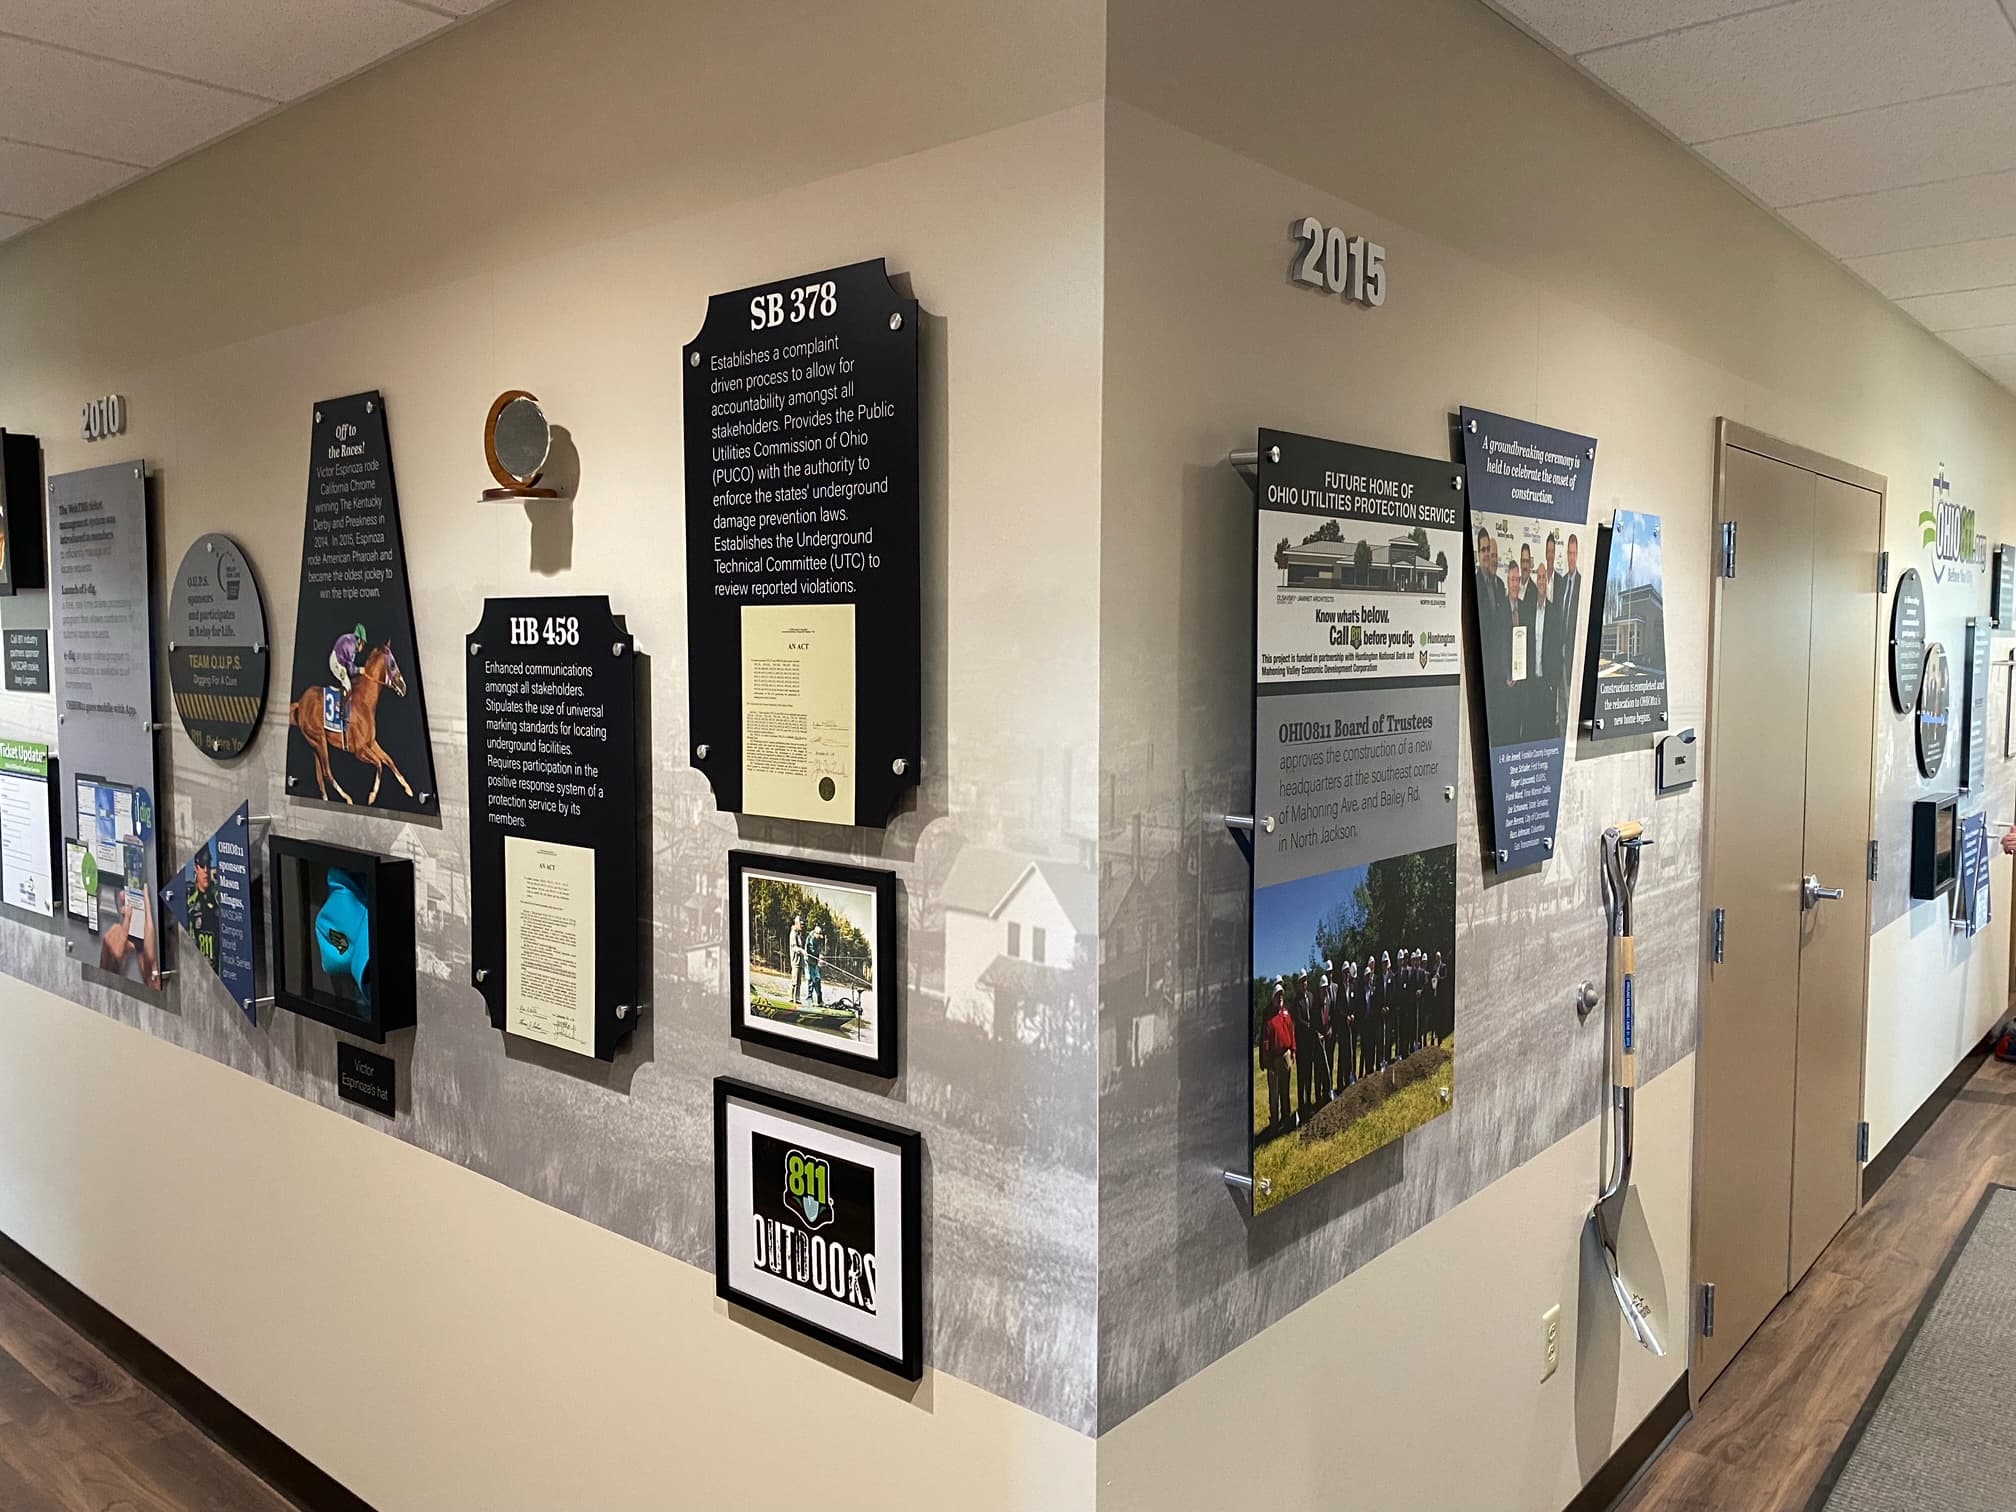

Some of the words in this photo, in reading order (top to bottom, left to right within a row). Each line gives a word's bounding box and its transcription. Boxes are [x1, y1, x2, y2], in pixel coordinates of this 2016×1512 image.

[1294, 217, 1386, 306] 2015
[750, 292, 784, 331] SB
[790, 281, 836, 322] 378
[710, 348, 769, 371] Establishes
[772, 348, 779, 360] a
[782, 335, 839, 359] complaint
[710, 377, 742, 393] driven
[746, 370, 788, 392] process
[791, 367, 802, 381] to
[805, 361, 835, 379] allow
[839, 357, 854, 373] for
[711, 392, 785, 416] accountability
[788, 384, 837, 406] amongst
[840, 380, 853, 398] all
[81, 394, 121, 439] 2010
[711, 417, 780, 439] stakeholders.
[784, 410, 832, 429] Provides
[835, 407, 854, 423] the
[858, 401, 894, 420] Public
[335, 423, 348, 441] Off
[348, 424, 356, 436] to
[712, 443, 750, 461] Utilities
[753, 436, 821, 457] Commission
[825, 431, 837, 449] of
[839, 429, 868, 447] Ohio
[328, 445, 340, 459] the
[341, 440, 365, 457] Races!
[1481, 436, 1488, 449] A
[1488, 439, 1544, 464] groundbreaking
[1544, 451, 1574, 470] ceremony
[1574, 454, 1580, 468] is
[712, 465, 754, 487] (PUCO)
[757, 463, 780, 479] with
[783, 461, 801, 477] the
[803, 455, 854, 475] authority
[858, 455, 870, 470] to
[1486, 458, 1502, 474] held
[1503, 462, 1510, 475] to
[1511, 463, 1541, 481] celebrate
[1541, 468, 1552, 483] the
[1552, 474, 1568, 486] onset
[1568, 473, 1577, 491] of
[712, 489, 752, 507] enforce
[754, 487, 772, 503] the
[774, 483, 809, 502] states'
[812, 476, 887, 500] underground
[1325, 471, 1366, 492] FUTURE
[1369, 478, 1398, 497] HOME
[1400, 482, 1413, 499] OF
[1511, 487, 1553, 504] construction.
[1268, 485, 1298, 504] OHIO
[1301, 489, 1351, 511] UTILITIES
[1354, 496, 1416, 519] PROTECTION
[1418, 504, 1455, 524] SERVICE
[713, 513, 756, 531] damage
[759, 507, 816, 529] prevention
[820, 506, 848, 521] laws.
[714, 534, 773, 551] Establishes
[775, 532, 793, 548] the
[796, 527, 872, 549] Underground
[713, 556, 762, 573] Technical
[765, 555, 827, 571] Committee
[830, 552, 864, 572] (UTC)
[868, 553, 880, 568] to
[714, 580, 748, 596] review
[751, 578, 797, 598] reported
[800, 578, 856, 593] violations.
[1315, 608, 1336, 623] Know
[1336, 609, 1359, 623] what's
[1360, 605, 1389, 623] below.
[510, 617, 539, 644] HB
[542, 616, 579, 645] 458
[1329, 625, 1349, 645] Call
[1363, 630, 1387, 645] before
[1388, 633, 1401, 648] you
[1401, 630, 1415, 647] dig.
[188, 654, 209, 668] TEAM
[211, 655, 242, 670] O.U.P.S.
[485, 660, 523, 674] Enhanced
[524, 663, 592, 677] communications
[485, 682, 518, 696] amongst
[520, 681, 529, 694] all
[531, 682, 584, 696] stakeholders.
[326, 693, 334, 721] 3
[485, 698, 523, 713] Stipulates
[524, 700, 538, 713] the
[539, 704, 554, 714] use
[555, 702, 564, 715] of
[566, 704, 603, 717] universal
[486, 717, 517, 734] marking
[518, 720, 558, 734] standards
[559, 721, 571, 735] for
[573, 722, 606, 741] locating
[1278, 721, 1331, 743] OHIO811
[1333, 718, 1369, 737] Board
[1372, 714, 1384, 733] of
[1386, 714, 1432, 732] Trustees
[486, 737, 536, 753] underground
[538, 740, 572, 755] facilities.
[1280, 751, 1324, 773] approves
[1326, 747, 1341, 764] the
[1343, 741, 1396, 762] construction
[1398, 738, 1407, 754] of
[1408, 743, 1413, 753] a
[1415, 740, 1432, 752] new
[487, 754, 521, 770] Requires
[522, 758, 572, 775] participation
[574, 762, 582, 775] in
[584, 763, 598, 777] the
[487, 775, 517, 788] positive
[518, 779, 555, 792] response
[556, 783, 585, 797] system
[587, 784, 596, 797] of
[598, 787, 603, 798] a
[1279, 775, 1342, 800] headquarters
[1343, 772, 1353, 787] at
[1355, 770, 1369, 785] the
[1371, 765, 1411, 783] southeast
[1413, 762, 1438, 777] corner
[488, 794, 526, 808] protection
[528, 798, 556, 812] service
[558, 799, 568, 816] by
[570, 801, 580, 815] its
[1278, 805, 1289, 824] of
[1291, 799, 1338, 824] Mahoning
[1340, 797, 1359, 816] Ave.
[1361, 792, 1378, 810] and
[1380, 789, 1405, 807] Bailey
[1407, 786, 1420, 802] Rd.
[488, 812, 525, 827] members.
[218, 841, 244, 857] OHIO811
[1278, 833, 1287, 852] in
[1290, 827, 1318, 849] North
[1320, 824, 1358, 844] Jackson.
[219, 861, 246, 875] sponsors
[220, 875, 240, 890] Mason
[199, 933, 213, 959] 811
[354, 1059, 375, 1077] Victor
[789, 1155, 826, 1204] 811
[752, 1213, 878, 1312] OUTDOORS
